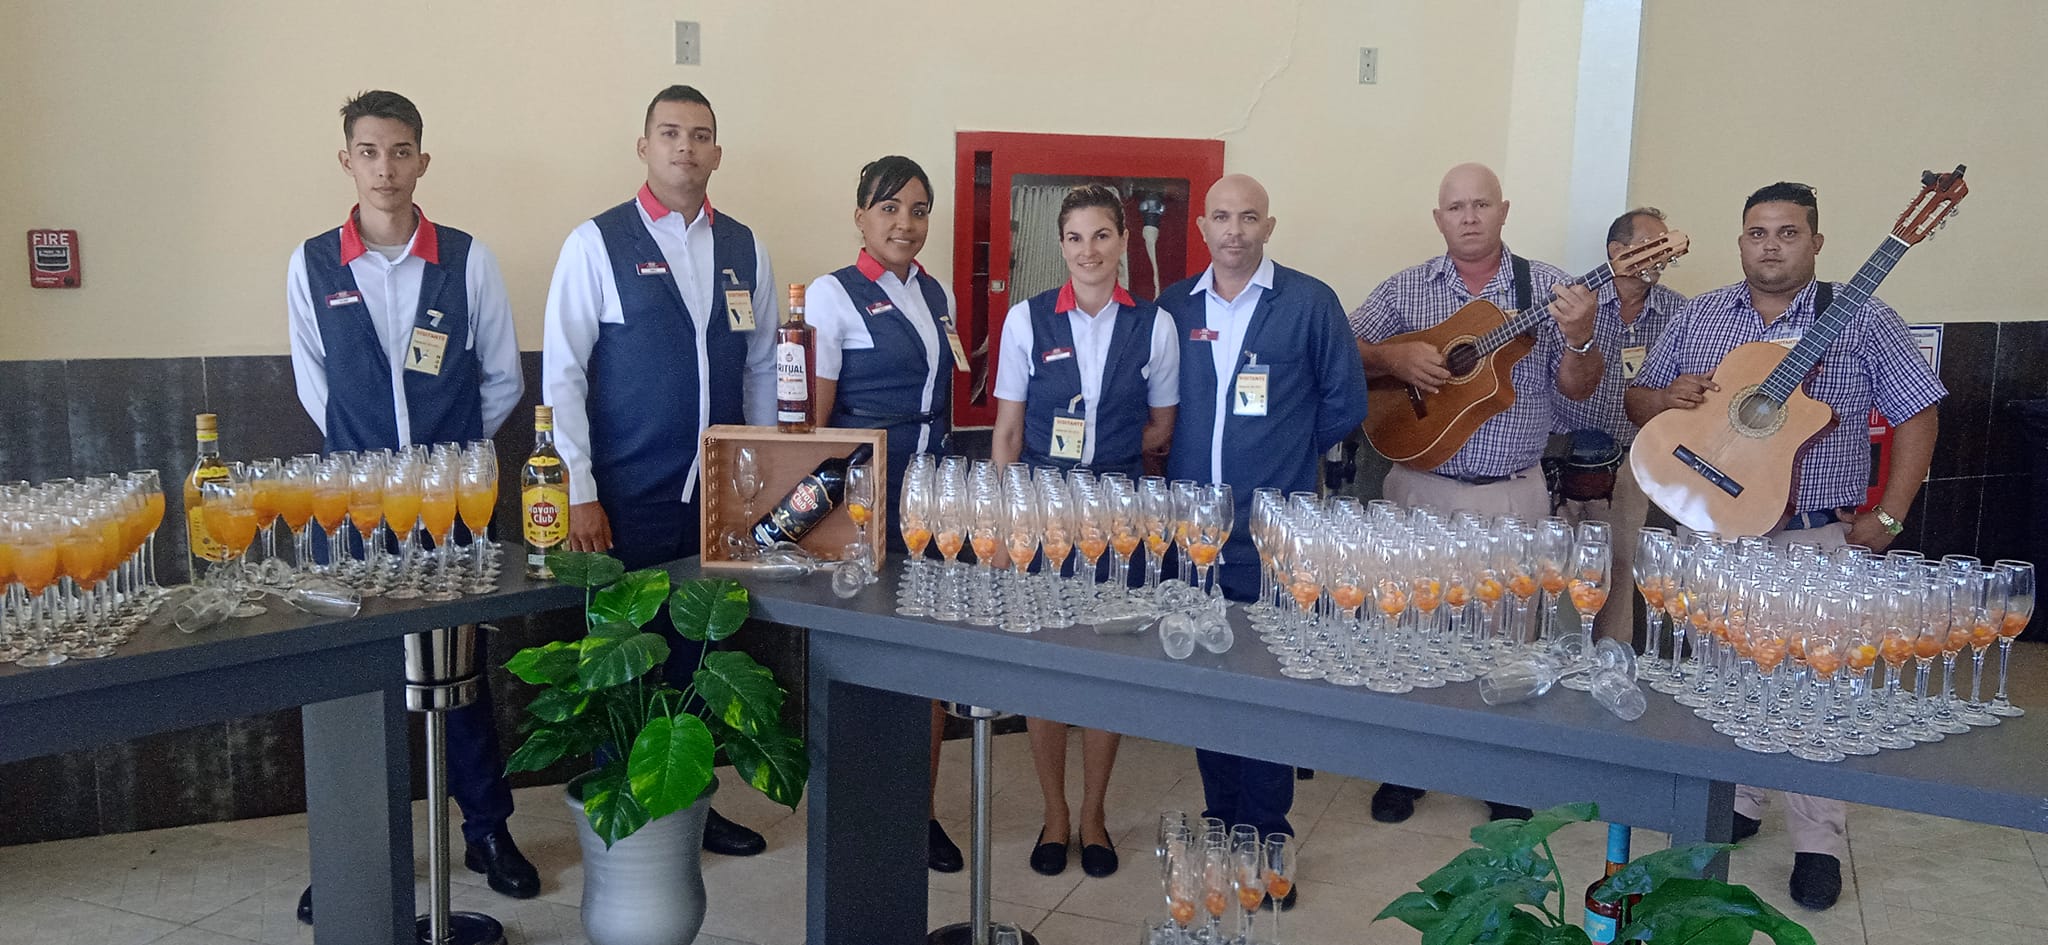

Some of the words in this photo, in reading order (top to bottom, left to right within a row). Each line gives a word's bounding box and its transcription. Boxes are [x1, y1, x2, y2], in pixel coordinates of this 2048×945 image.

[33, 233, 69, 245] FIRE
[778, 363, 804, 375] RITUAL
[793, 493, 807, 510] Club
[528, 506, 560, 514] Havana
[533, 514, 554, 523] Club
